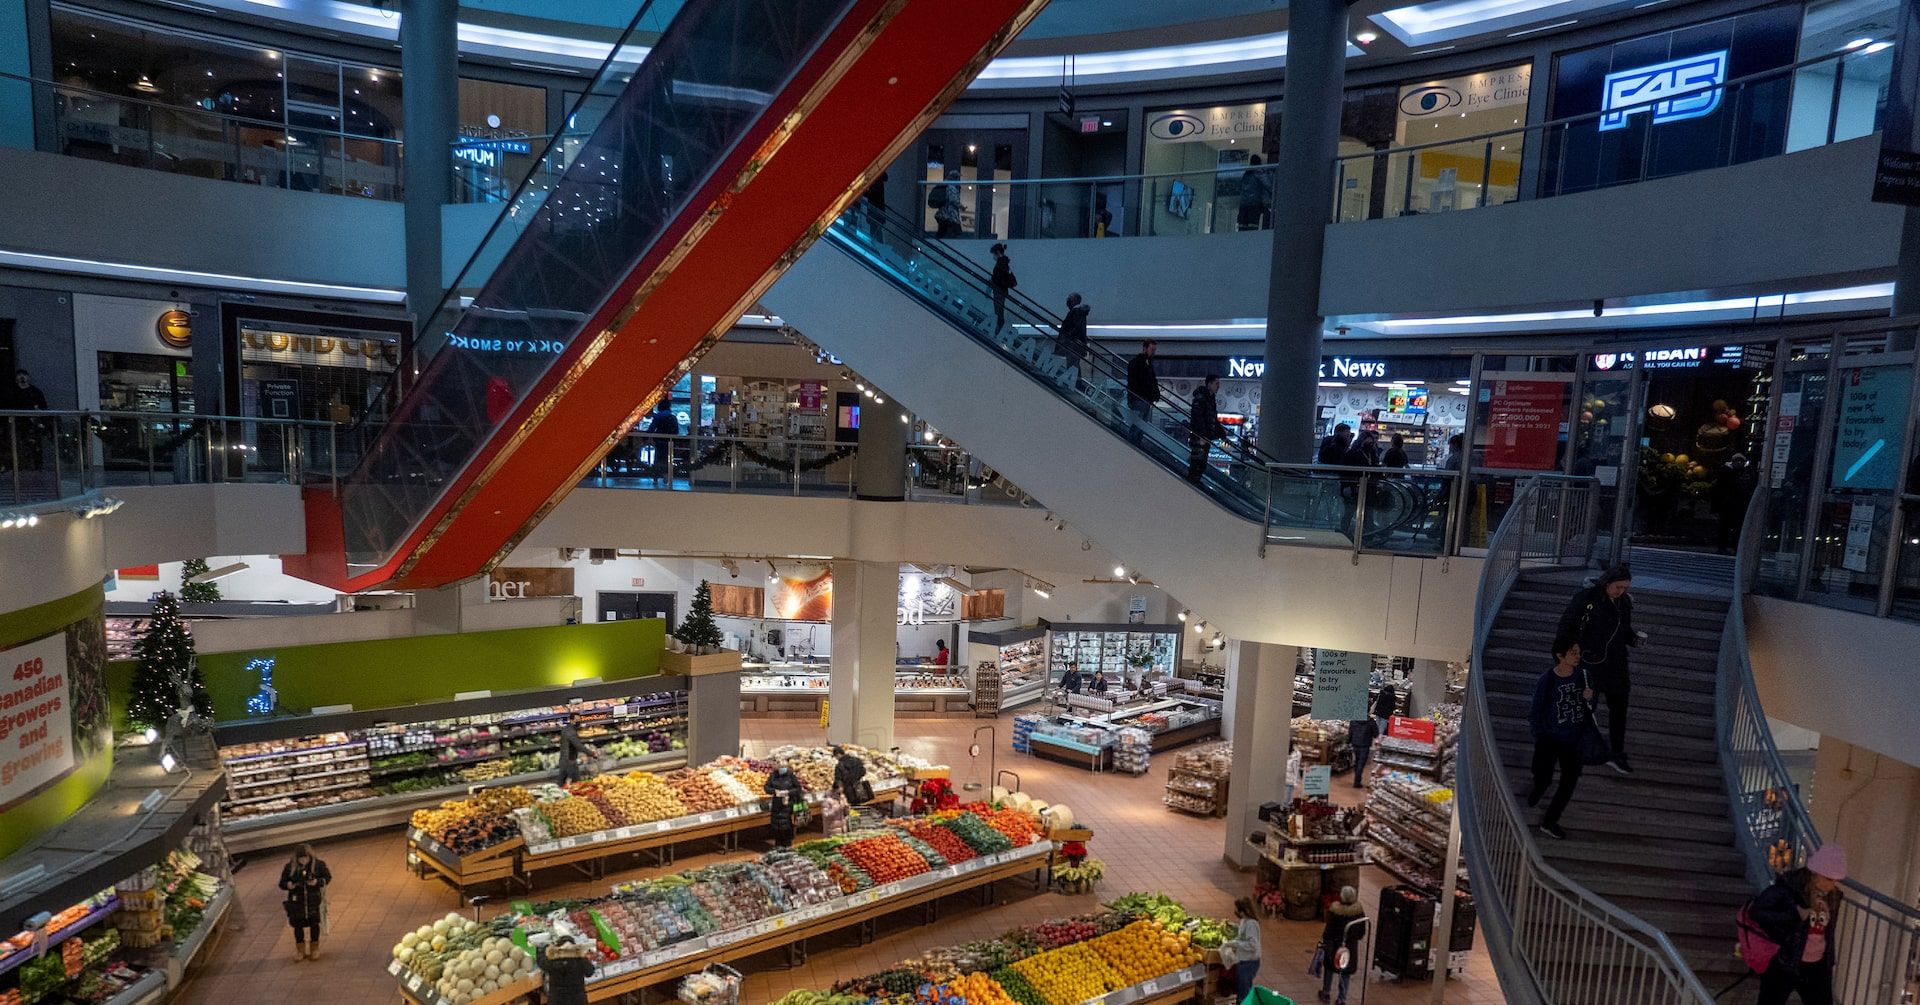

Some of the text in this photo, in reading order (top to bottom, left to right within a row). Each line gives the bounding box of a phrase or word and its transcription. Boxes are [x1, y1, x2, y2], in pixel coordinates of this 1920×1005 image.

[1469, 73, 1531, 89] EMPRESS
[1468, 86, 1529, 108] Eye Clinic
[1599, 50, 1728, 132] F45
[1211, 110, 1266, 121] EMPRESS
[1211, 121, 1264, 136] Eye Clinic
[1332, 358, 1385, 377] News
[1351, 398, 1360, 406] 25
[1850, 391, 1878, 401] 100s of
[1456, 403, 1466, 412] 43
[1865, 403, 1875, 412] PC
[1846, 416, 1885, 425] favourites
[1854, 428, 1865, 438] try
[13, 656, 43, 681] 450
[1328, 677, 1339, 685] try
[1318, 685, 1341, 693] today!
[0, 696, 62, 740] growers
[19, 720, 48, 749] and
[1, 735, 64, 786] growing
